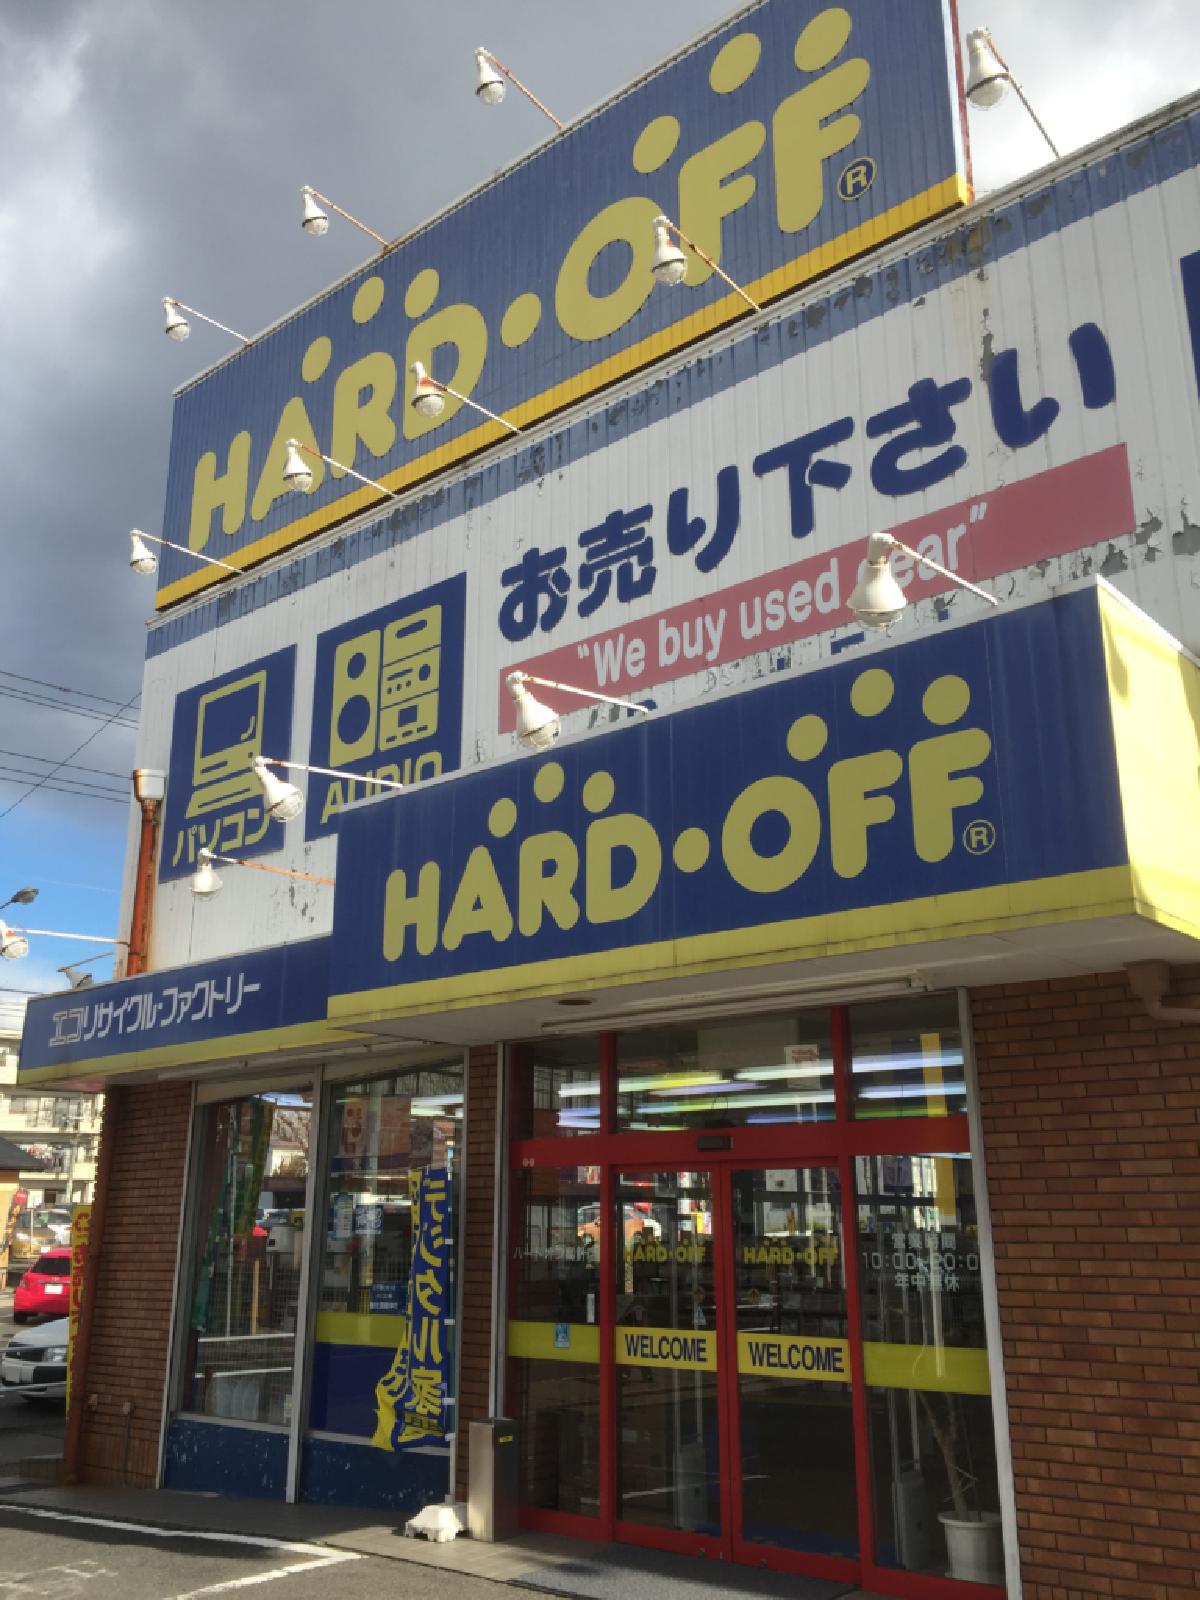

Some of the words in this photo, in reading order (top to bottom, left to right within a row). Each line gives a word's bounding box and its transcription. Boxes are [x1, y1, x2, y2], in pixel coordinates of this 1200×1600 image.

[498, 321, 1117, 642] お売り下さい
[658, 608, 727, 668] buy
[739, 557, 842, 640] used
[171, 807, 271, 867] パソコン
[624, 1333, 708, 1363] WELCOME
[748, 1341, 845, 1374] WELCOME
